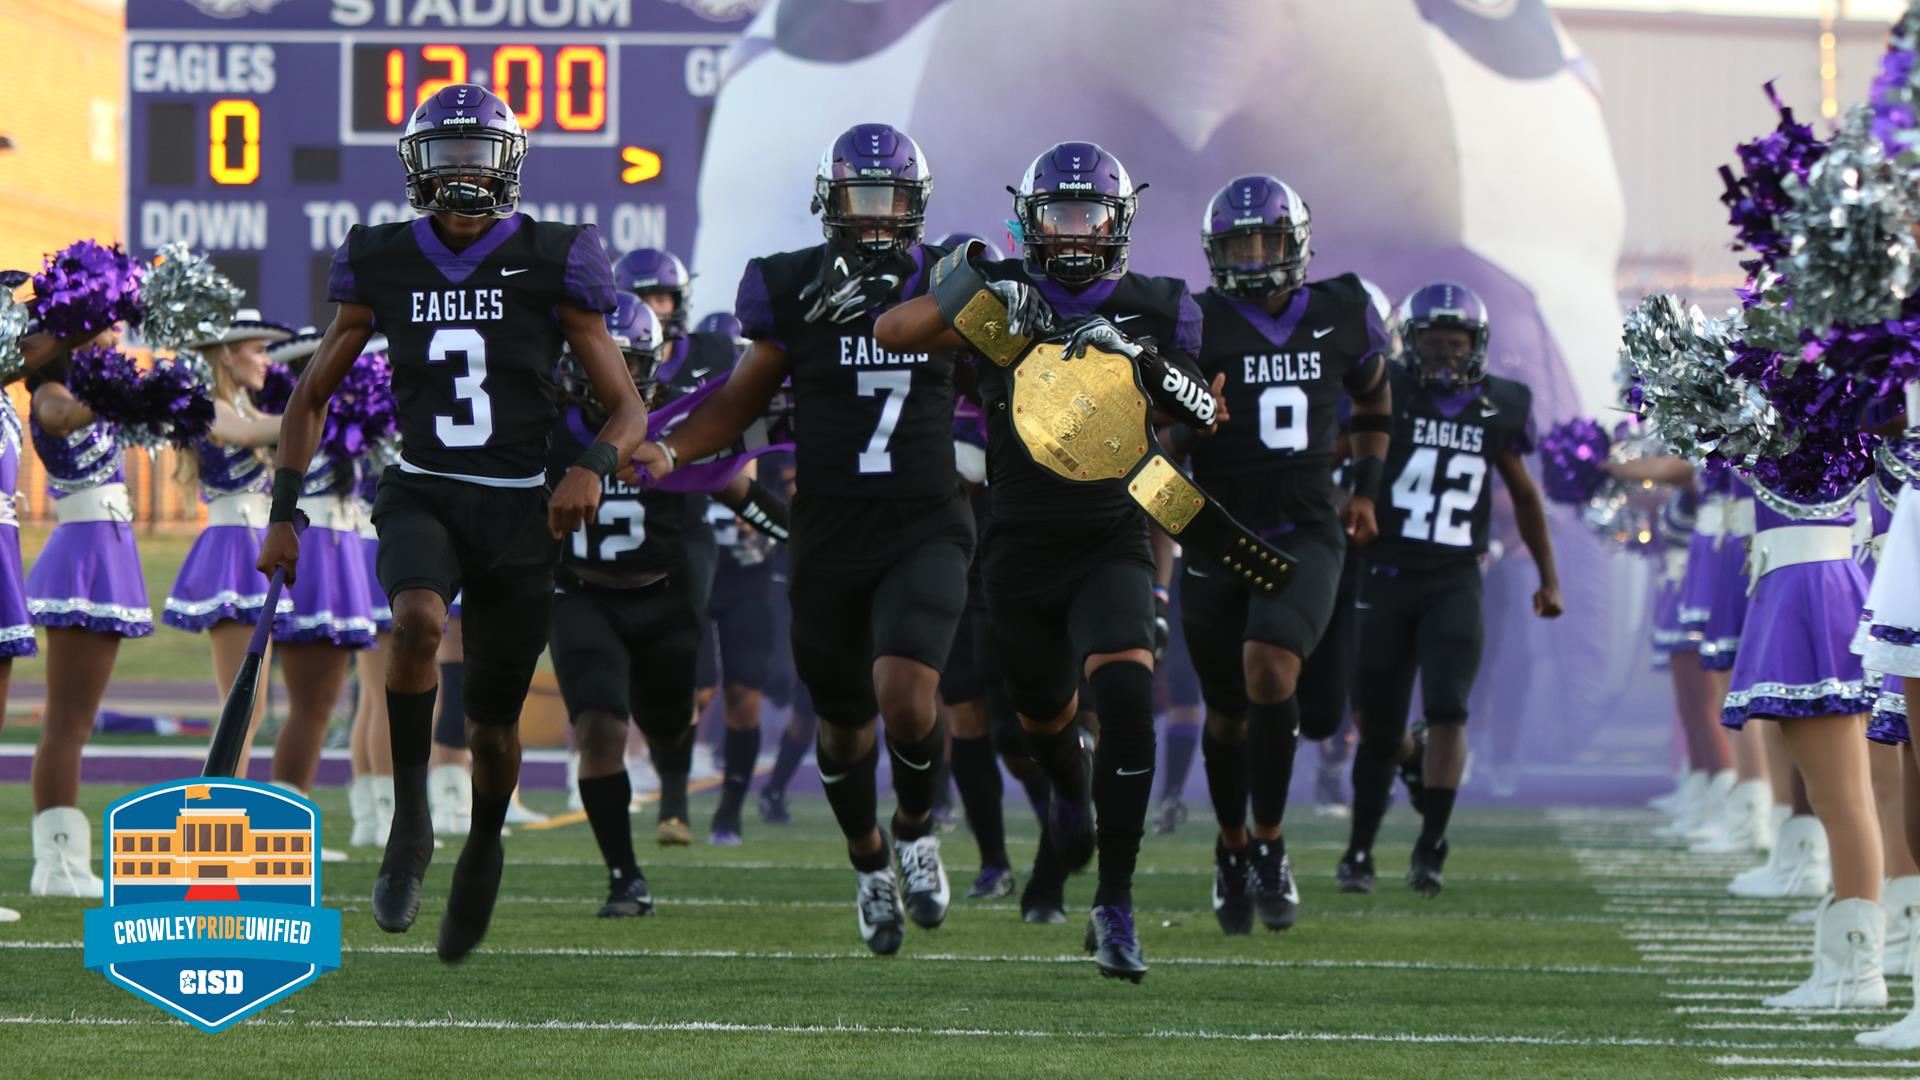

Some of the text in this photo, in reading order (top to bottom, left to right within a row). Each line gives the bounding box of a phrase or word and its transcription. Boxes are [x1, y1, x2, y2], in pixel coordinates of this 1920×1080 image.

[330, 0, 631, 27] STADIUM
[132, 43, 276, 93] EAGLES
[209, 98, 261, 185] 0
[443, 117, 477, 125] Riddell
[1059, 182, 1092, 190] Riddell
[140, 200, 268, 250] DOWN
[612, 202, 668, 254] ON
[411, 289, 504, 322] EAGLES
[428, 328, 493, 447] 3
[1243, 351, 1321, 383] EAGLES
[857, 370, 912, 473] 7
[1258, 386, 1309, 452] 9
[1412, 417, 1484, 453] EAGLES
[1391, 446, 1488, 547] 42
